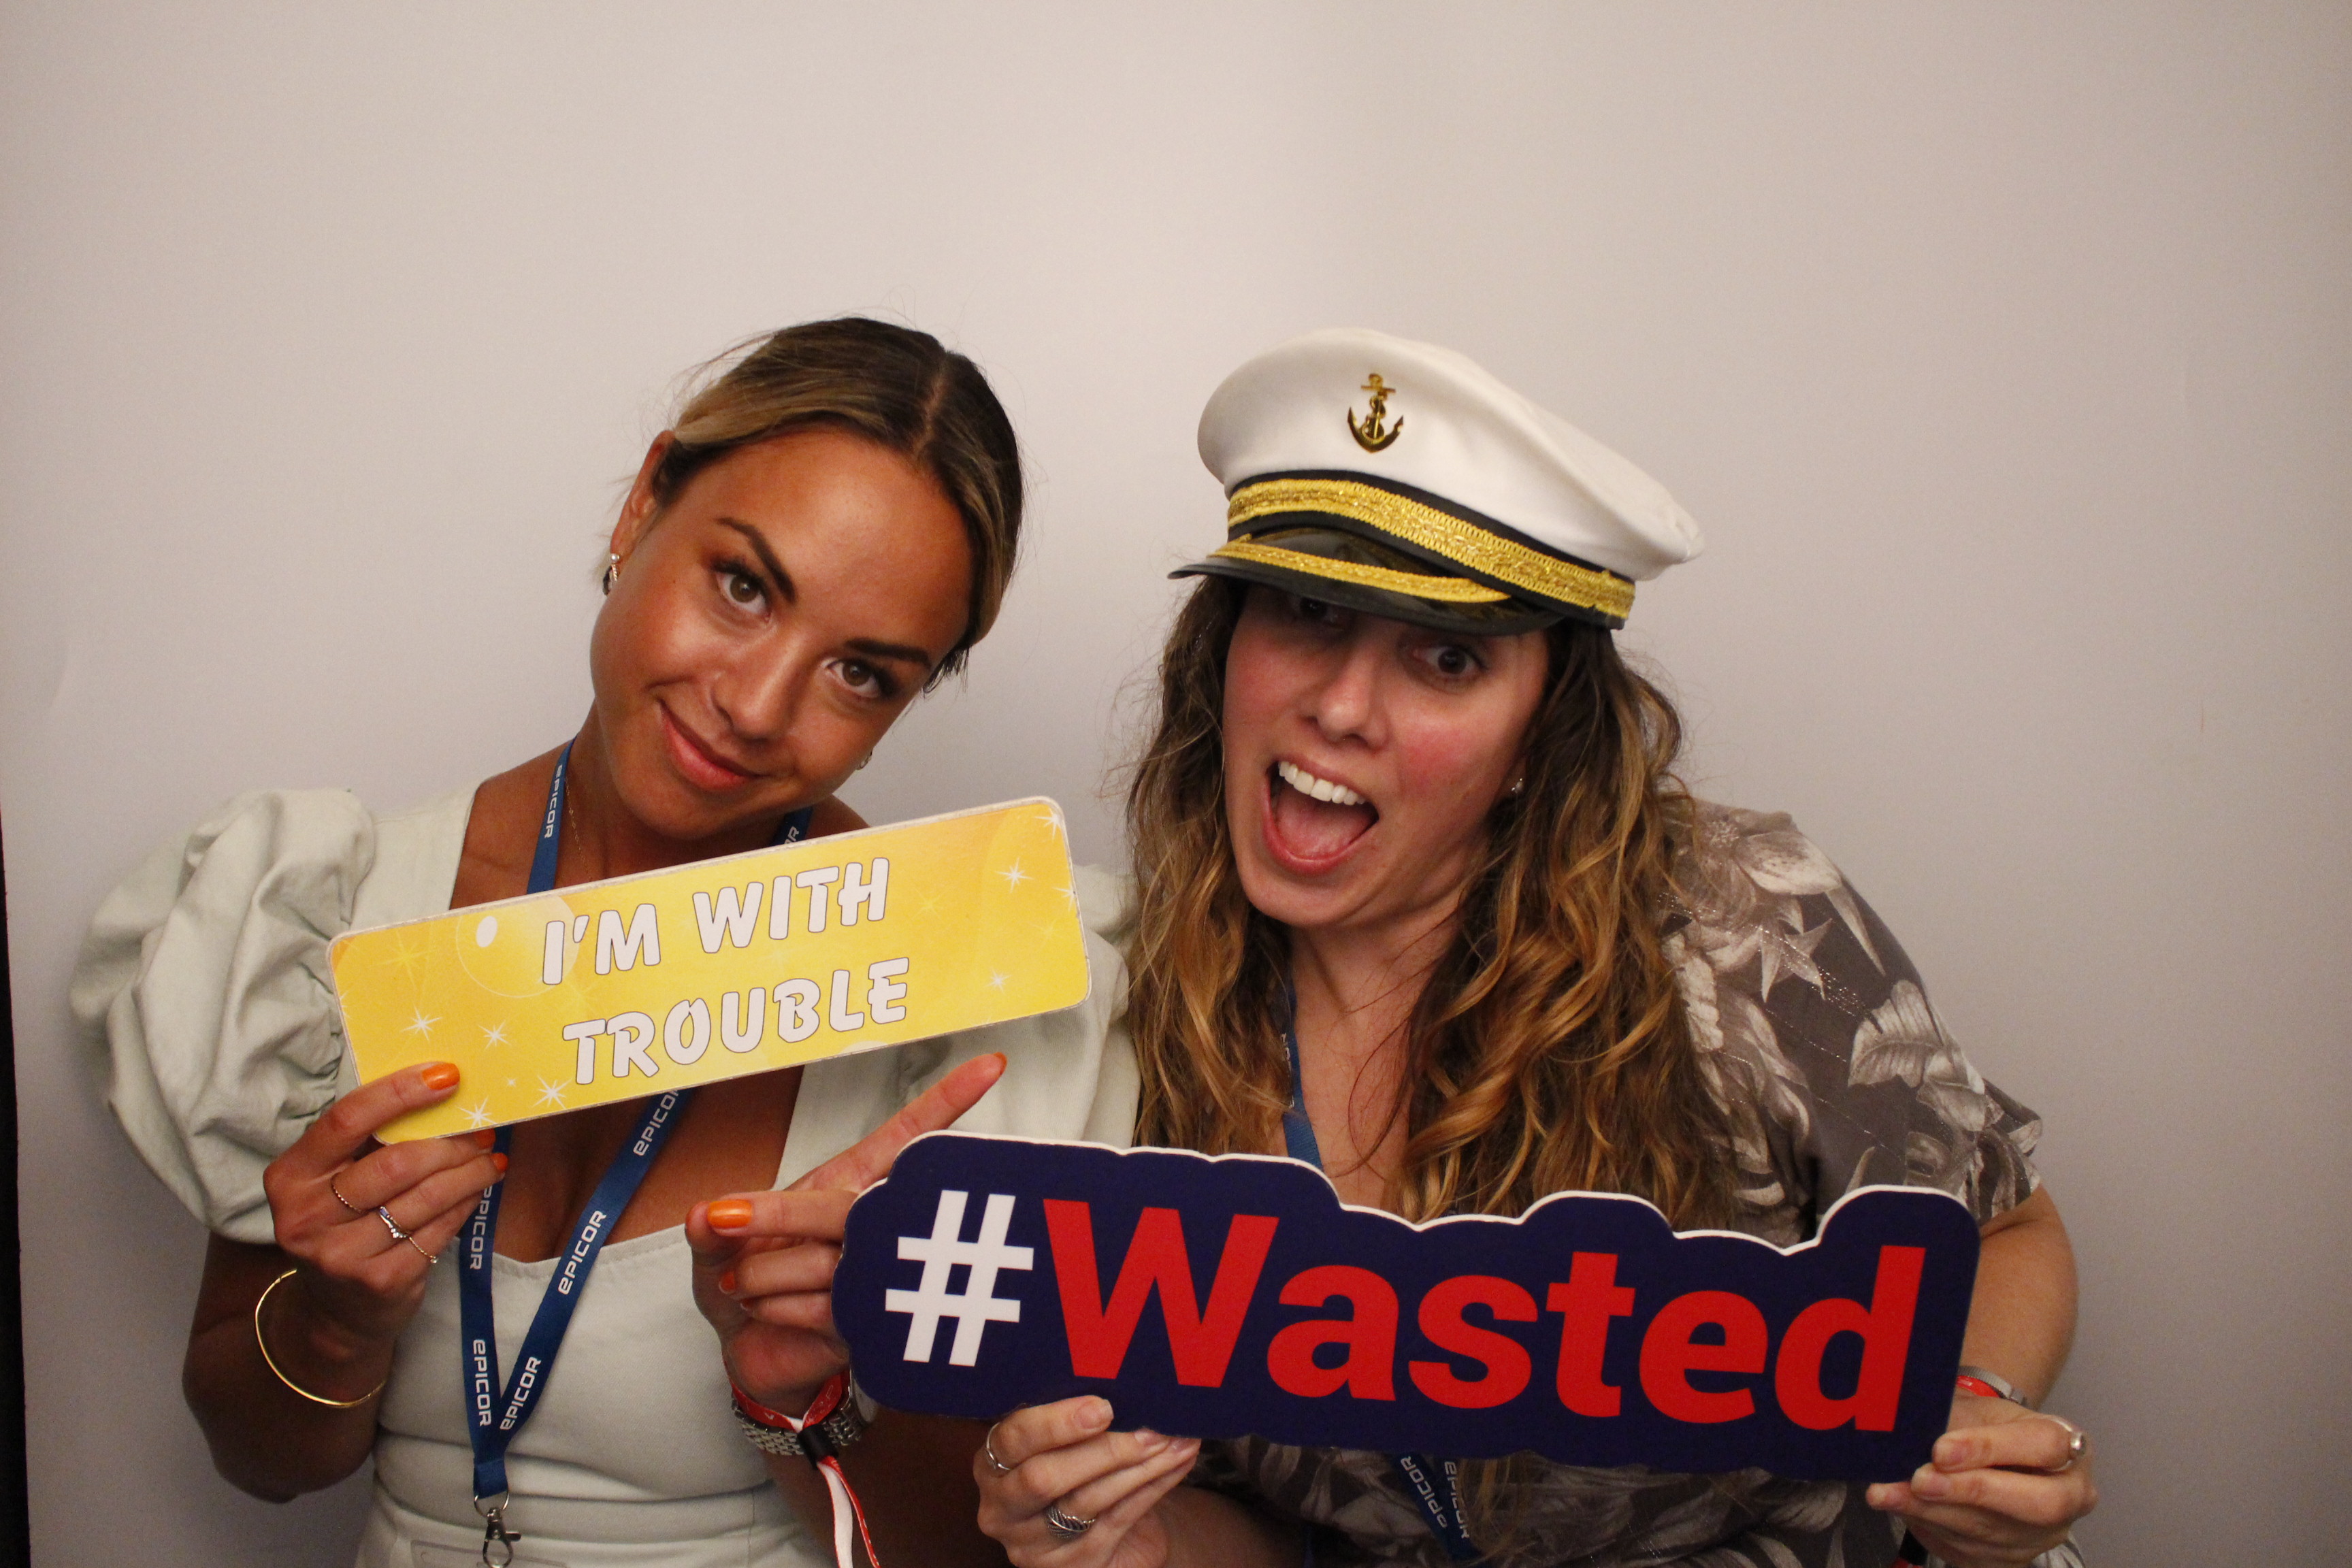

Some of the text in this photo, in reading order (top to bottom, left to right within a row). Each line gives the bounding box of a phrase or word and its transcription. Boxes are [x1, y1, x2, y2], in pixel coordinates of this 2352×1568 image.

[542, 857, 890, 985] I'M WITH
[562, 957, 910, 1085] TROUBLE
[885, 1189, 1925, 1432] #Wasted
